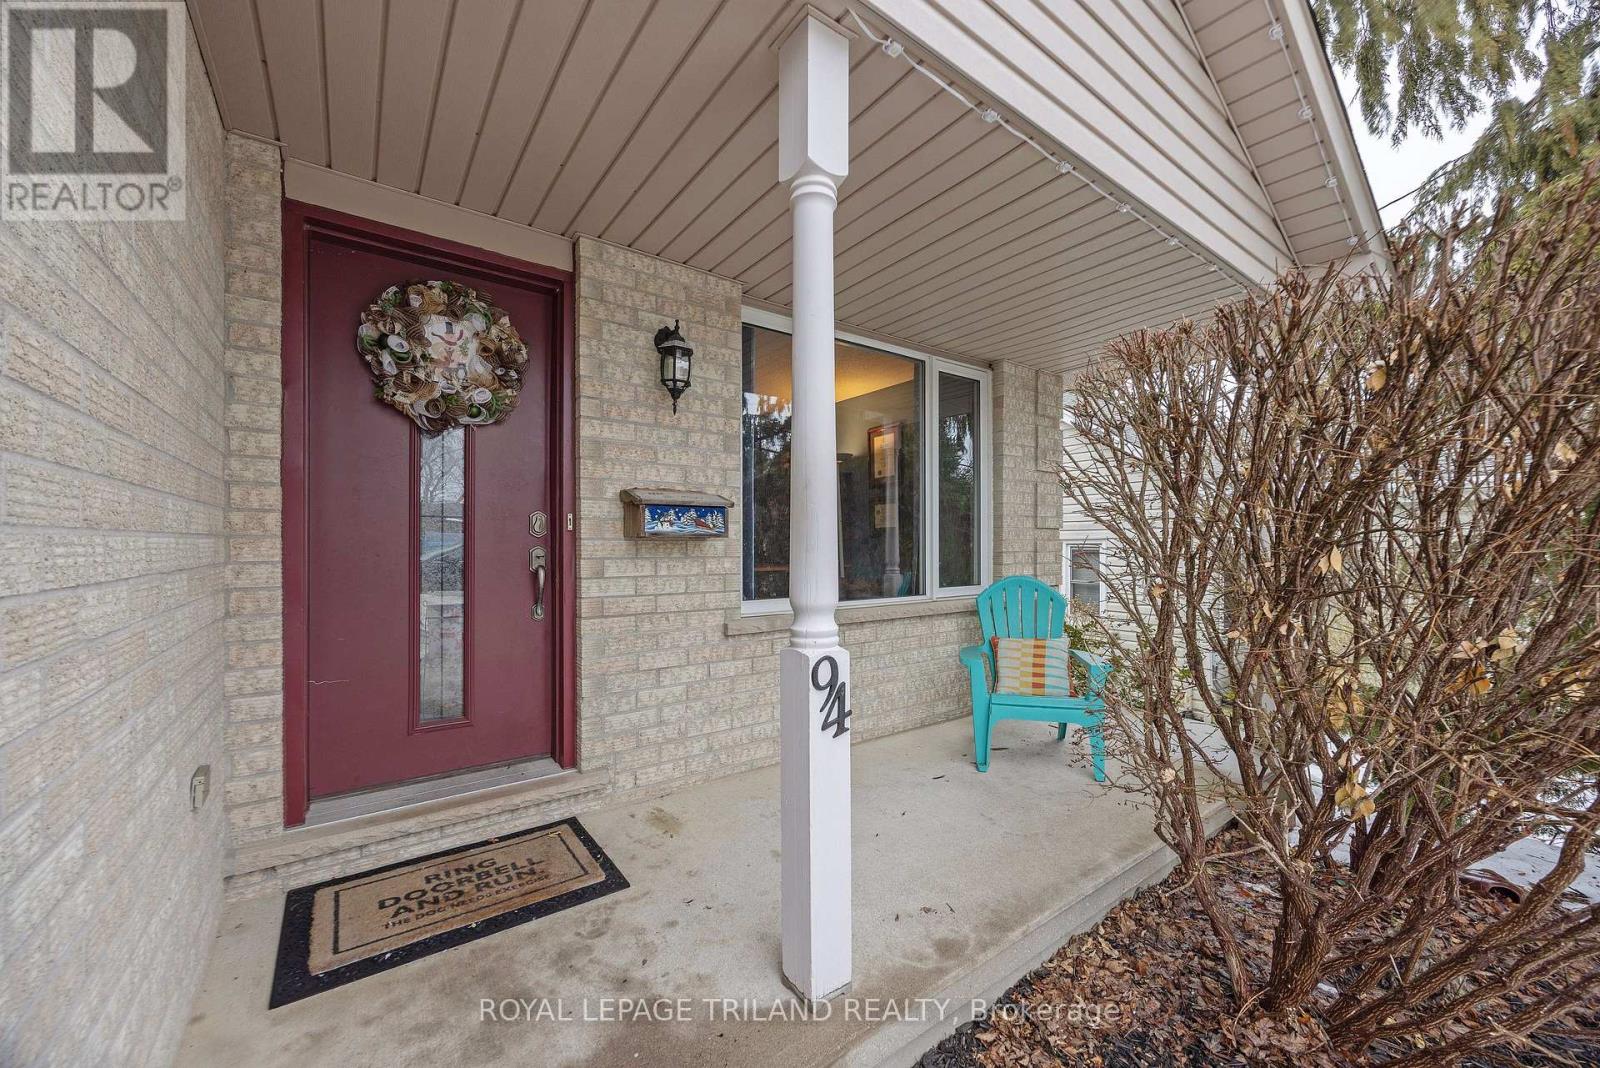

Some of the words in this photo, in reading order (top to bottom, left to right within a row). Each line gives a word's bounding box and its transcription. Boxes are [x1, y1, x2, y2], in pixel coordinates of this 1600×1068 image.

[811, 655, 853, 739] 94
[378, 857, 545, 910] DOORBELL
[424, 858, 497, 884] RING
[391, 890, 464, 918] AND
[416, 905, 447, 921] DOG
